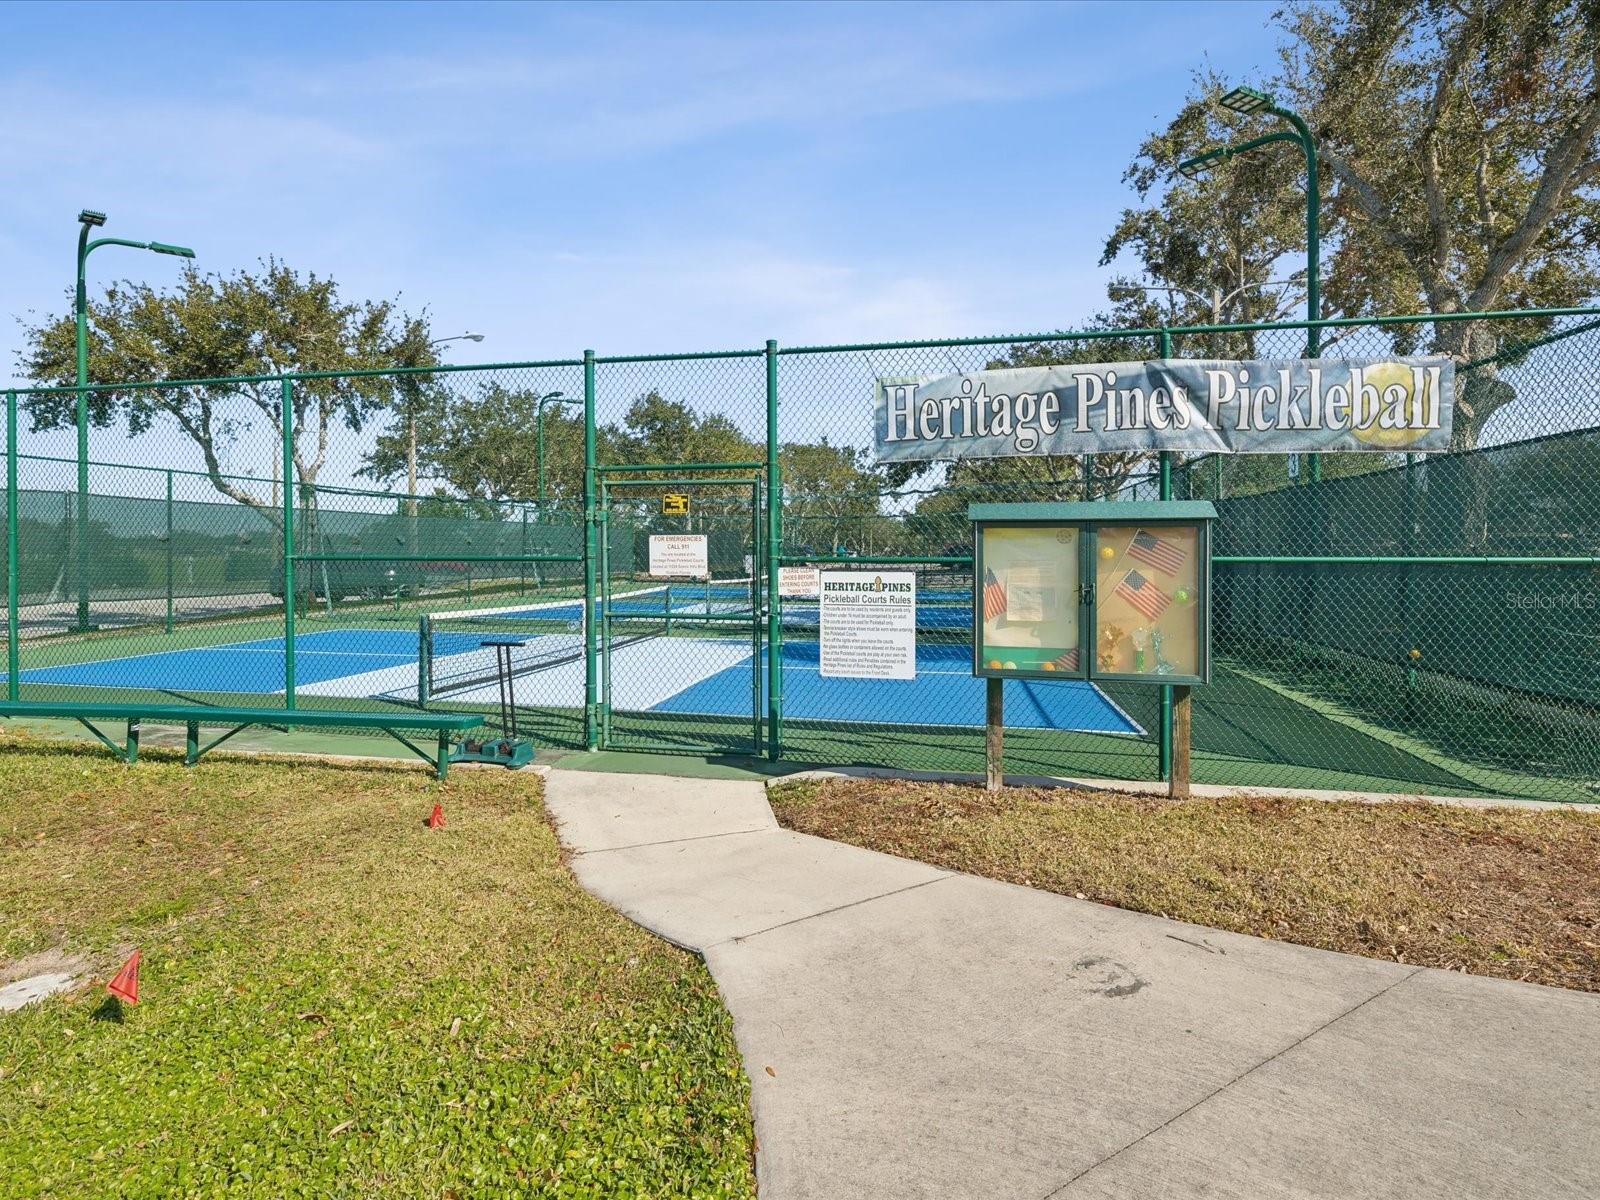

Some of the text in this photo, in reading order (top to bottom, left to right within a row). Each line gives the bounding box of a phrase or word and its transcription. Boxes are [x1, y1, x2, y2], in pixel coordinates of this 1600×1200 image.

[884, 365, 1440, 453] Heritage Pines Pickleball
[824, 582, 911, 593] HERITAGE PINES
[824, 594, 912, 605] Pickleball Courts Rules
